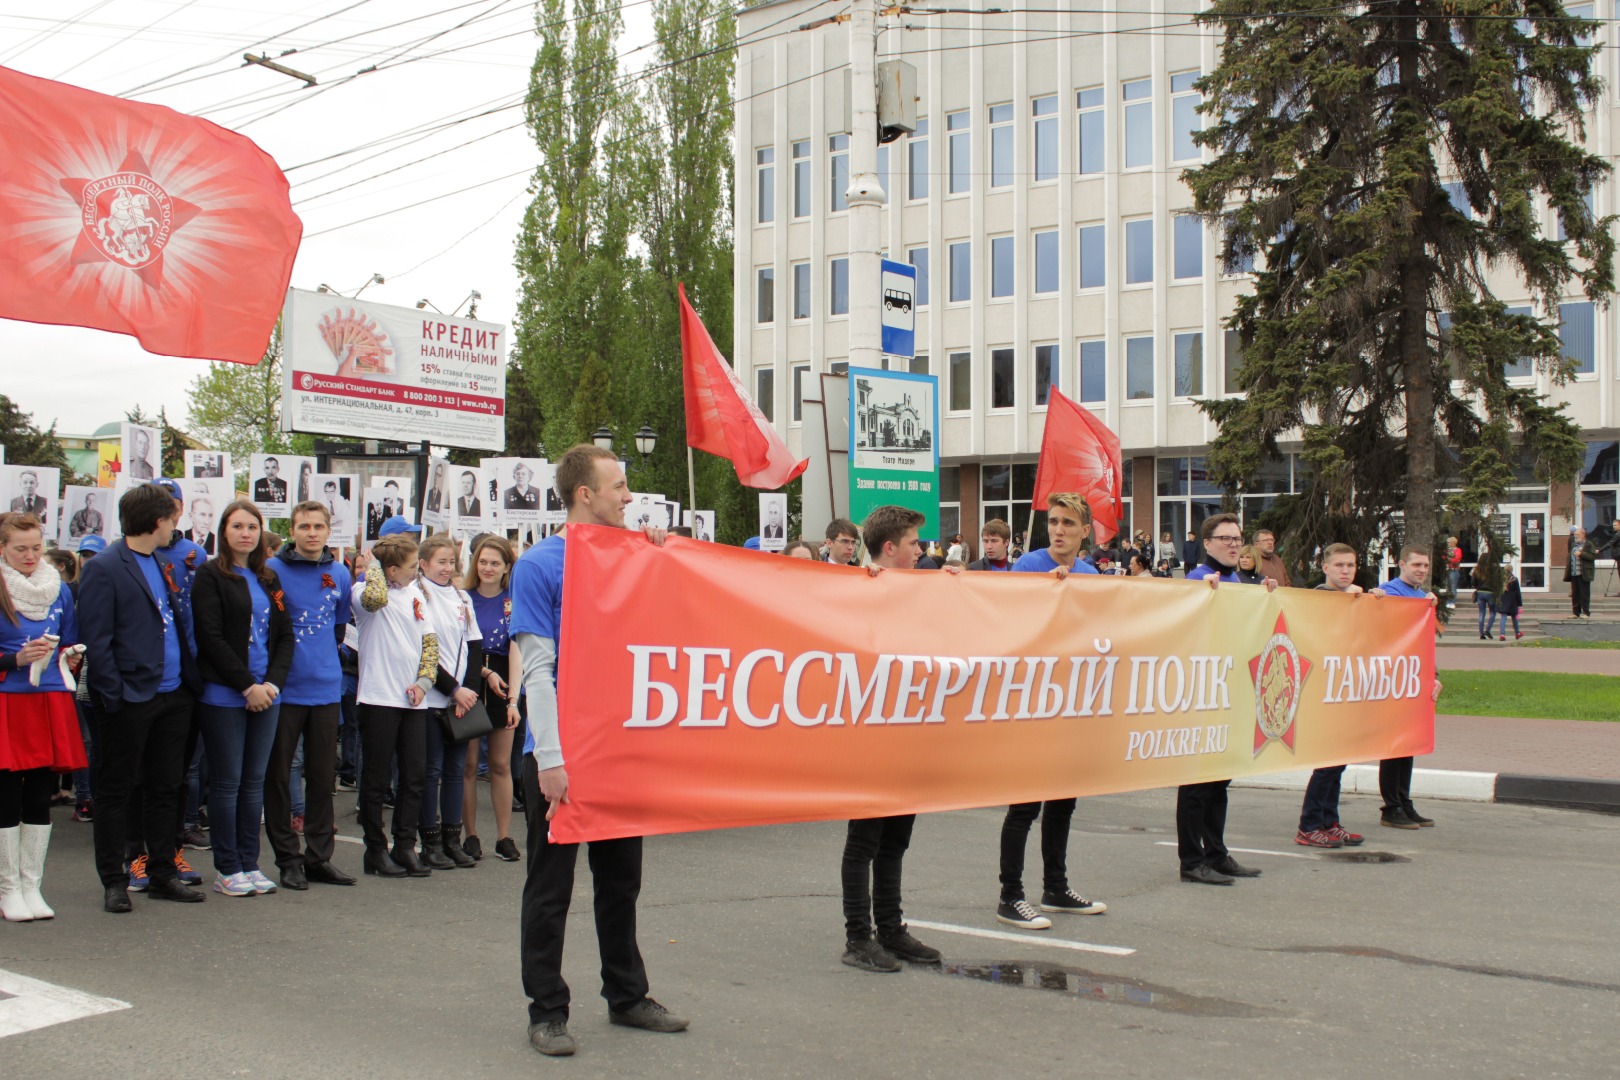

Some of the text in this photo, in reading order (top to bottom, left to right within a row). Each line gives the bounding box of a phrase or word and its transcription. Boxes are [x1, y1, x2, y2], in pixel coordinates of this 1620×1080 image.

[85, 173, 171, 249] БЕССМЕРТНЫЙ ПОЛК РОССИИ
[422, 319, 499, 350] КРЕДИТ
[421, 344, 497, 366] НАЛИЧНЫМИ
[421, 363, 441, 374] 15%
[443, 369, 463, 377] ставка
[473, 372, 498, 384] кредиту
[403, 391, 408, 399] 8
[409, 391, 423, 400] 800
[423, 393, 437, 403] 200
[438, 395, 443, 403] 3
[469, 381, 479, 391] 15
[313, 395, 395, 413] ИНТЕРНАЦИОНАЛЬНАЯ,
[882, 456, 896, 465] Театр
[622, 638, 1120, 728] БЕССМЕРТНЫЙ
[1124, 655, 1234, 714] ПОЛК
[1322, 655, 1421, 704] ТАМБОВ
[1124, 724, 1230, 761] POLKRF.RU
